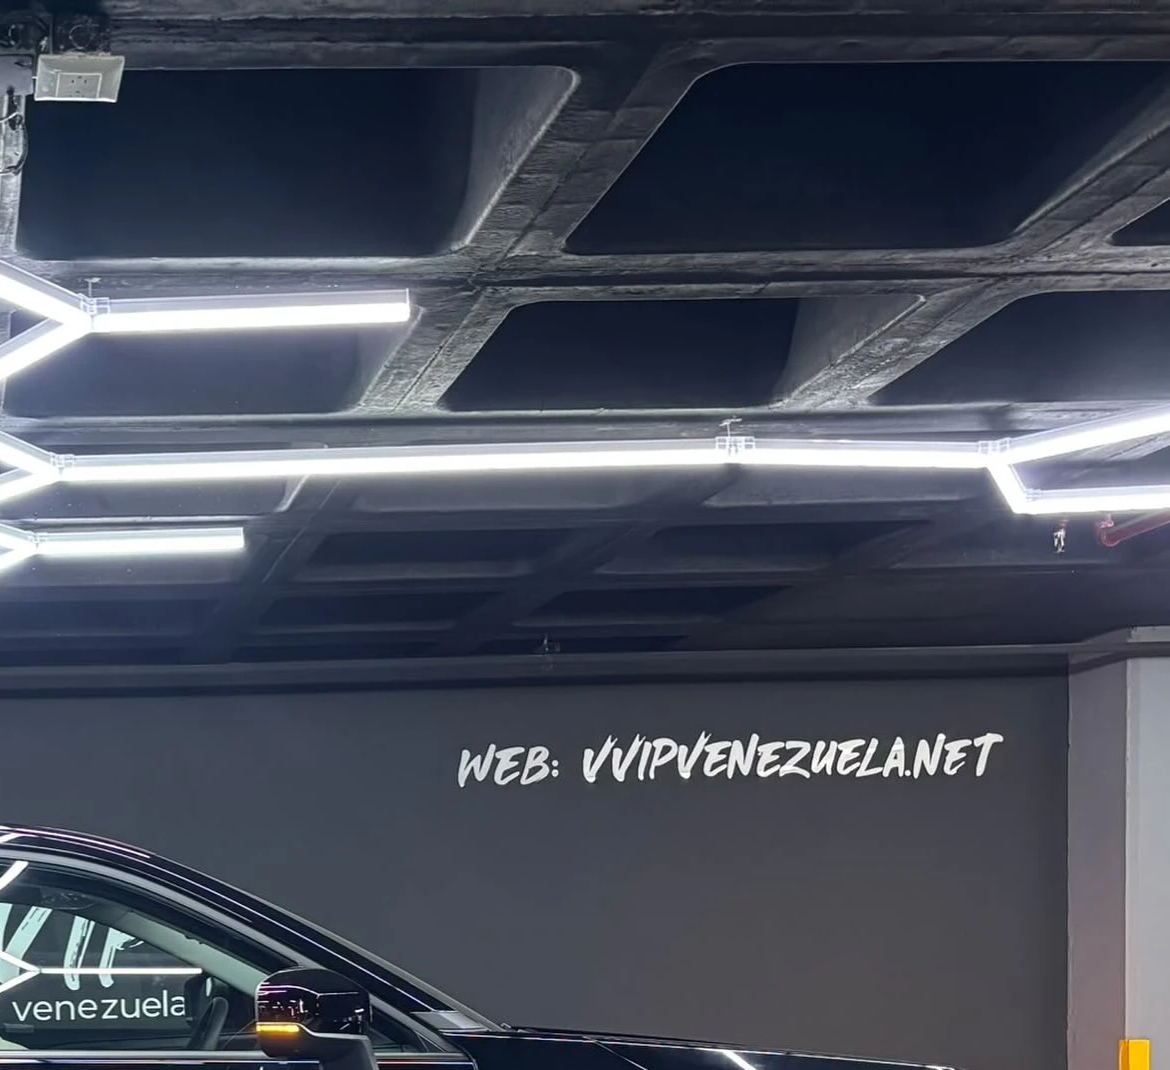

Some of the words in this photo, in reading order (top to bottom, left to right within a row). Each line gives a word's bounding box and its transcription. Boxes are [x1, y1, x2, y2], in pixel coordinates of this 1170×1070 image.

[458, 744, 559, 788] WEB:
[582, 731, 1004, 784] VVIPVENEZUELA.NET
[11, 989, 186, 1022] venezuela
